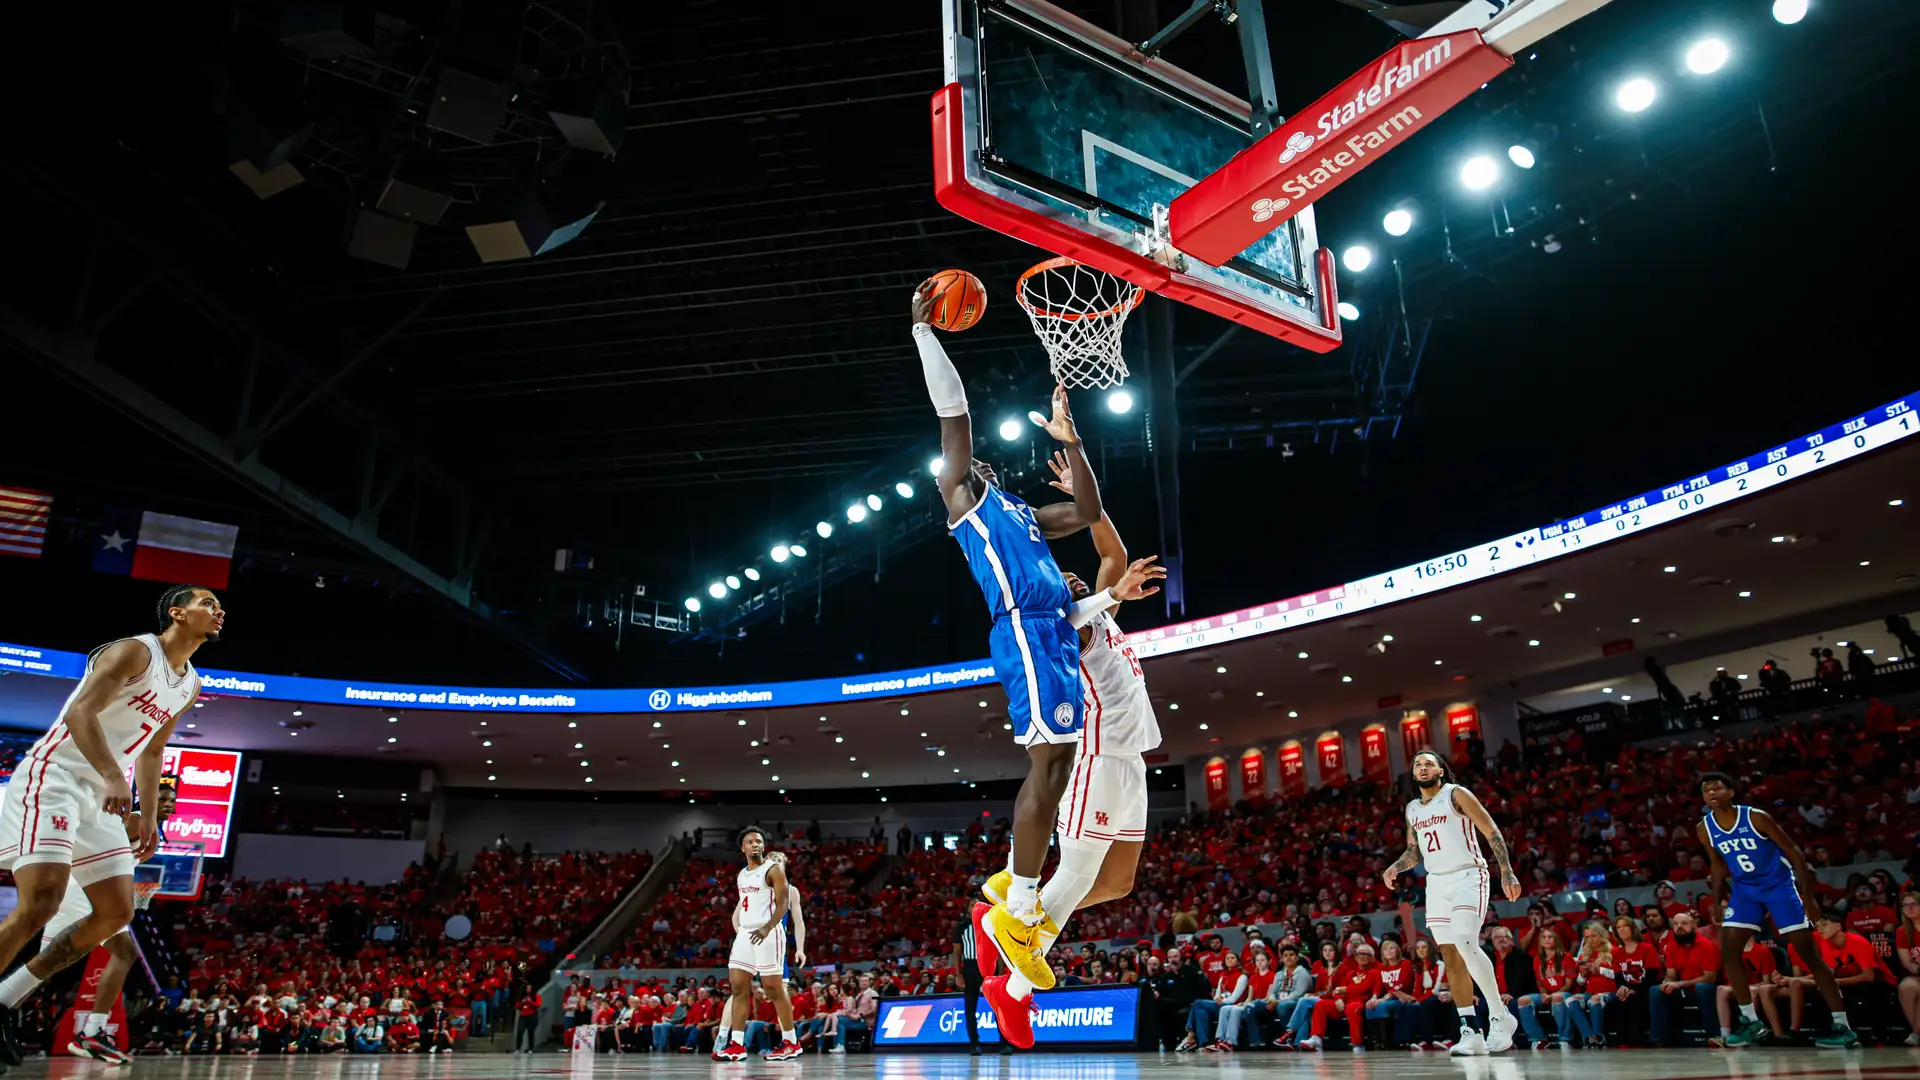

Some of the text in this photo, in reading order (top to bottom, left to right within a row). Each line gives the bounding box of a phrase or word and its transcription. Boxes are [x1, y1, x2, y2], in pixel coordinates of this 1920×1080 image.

[1726, 461, 1749, 478] REB
[1767, 446, 1788, 464] AST
[1806, 433, 1824, 448] TO
[1843, 416, 1868, 434] BLK
[1885, 400, 1910, 418] STL
[1560, 538, 1567, 548] 1
[1616, 519, 1625, 531] 0
[1632, 514, 1641, 526] 2
[1678, 498, 1688, 511] 0
[1694, 493, 1704, 506] 0
[1736, 478, 1748, 491] 2
[1777, 463, 1787, 477] 0
[1814, 450, 1825, 464] 2
[1854, 434, 1866, 449] 0
[1899, 417, 1910, 431] 1
[1384, 546, 1500, 589] 4 16:50 2
[1255, 620, 1263, 630] 0
[1306, 608, 1314, 618] 0
[1335, 601, 1343, 611] 0
[842, 665, 995, 696] Insurance and Employee
[345, 687, 576, 708] Insurance and Employee Benefits
[677, 689, 773, 707] Higginbotham
[1576, 711, 1601, 724] COLD
[124, 722, 153, 755] 7
[169, 817, 223, 837] rhythm
[1412, 815, 1447, 831] Houston
[1424, 830, 1441, 853] 21
[1718, 837, 1757, 855] BYU
[1736, 854, 1755, 872] 6
[742, 895, 749, 912] 4
[1030, 1007, 1113, 1027] FURNITURE
